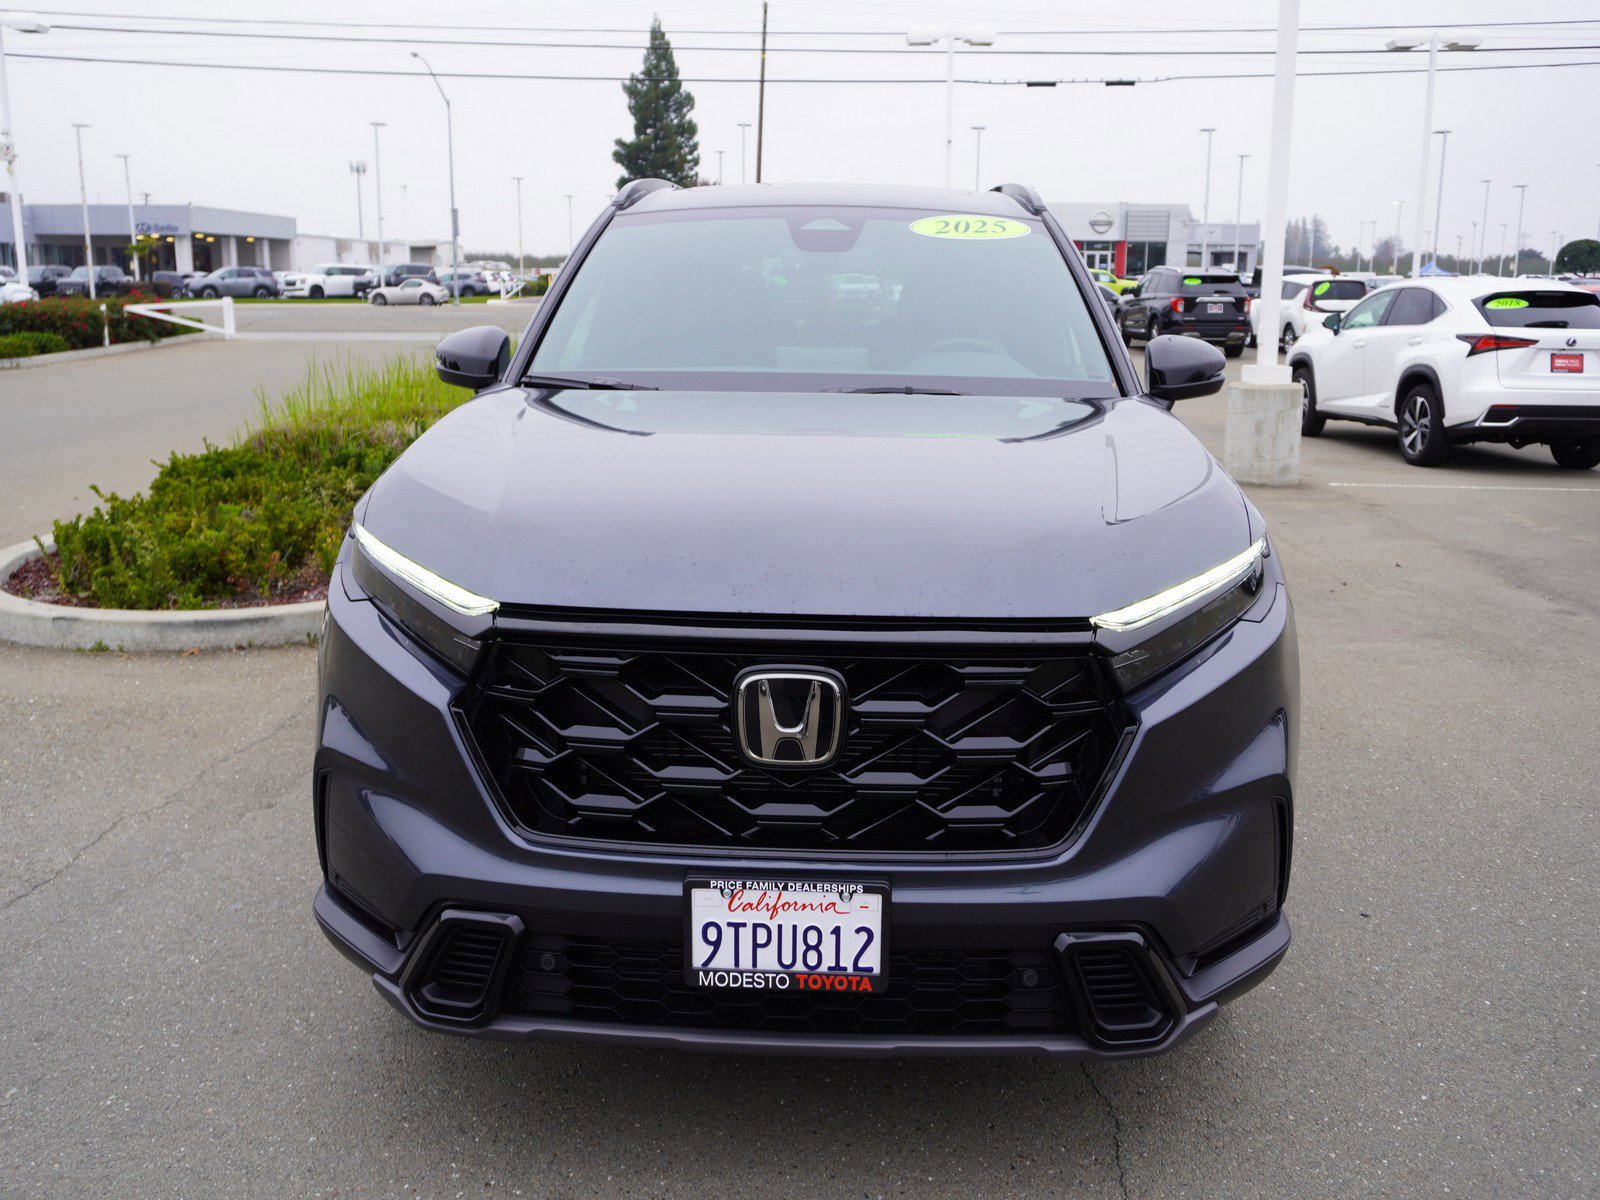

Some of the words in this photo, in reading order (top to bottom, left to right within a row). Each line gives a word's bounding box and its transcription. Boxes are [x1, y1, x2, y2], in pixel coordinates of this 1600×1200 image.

[935, 219, 1007, 234] 2025
[710, 880, 743, 890] PRICE
[746, 881, 785, 892] FAMILY
[787, 882, 864, 894] DEALERSHIPS
[727, 889, 850, 921] California
[701, 920, 875, 973] 9TPU812
[699, 971, 790, 989] MODESTO
[795, 973, 873, 992] TOYOTA
